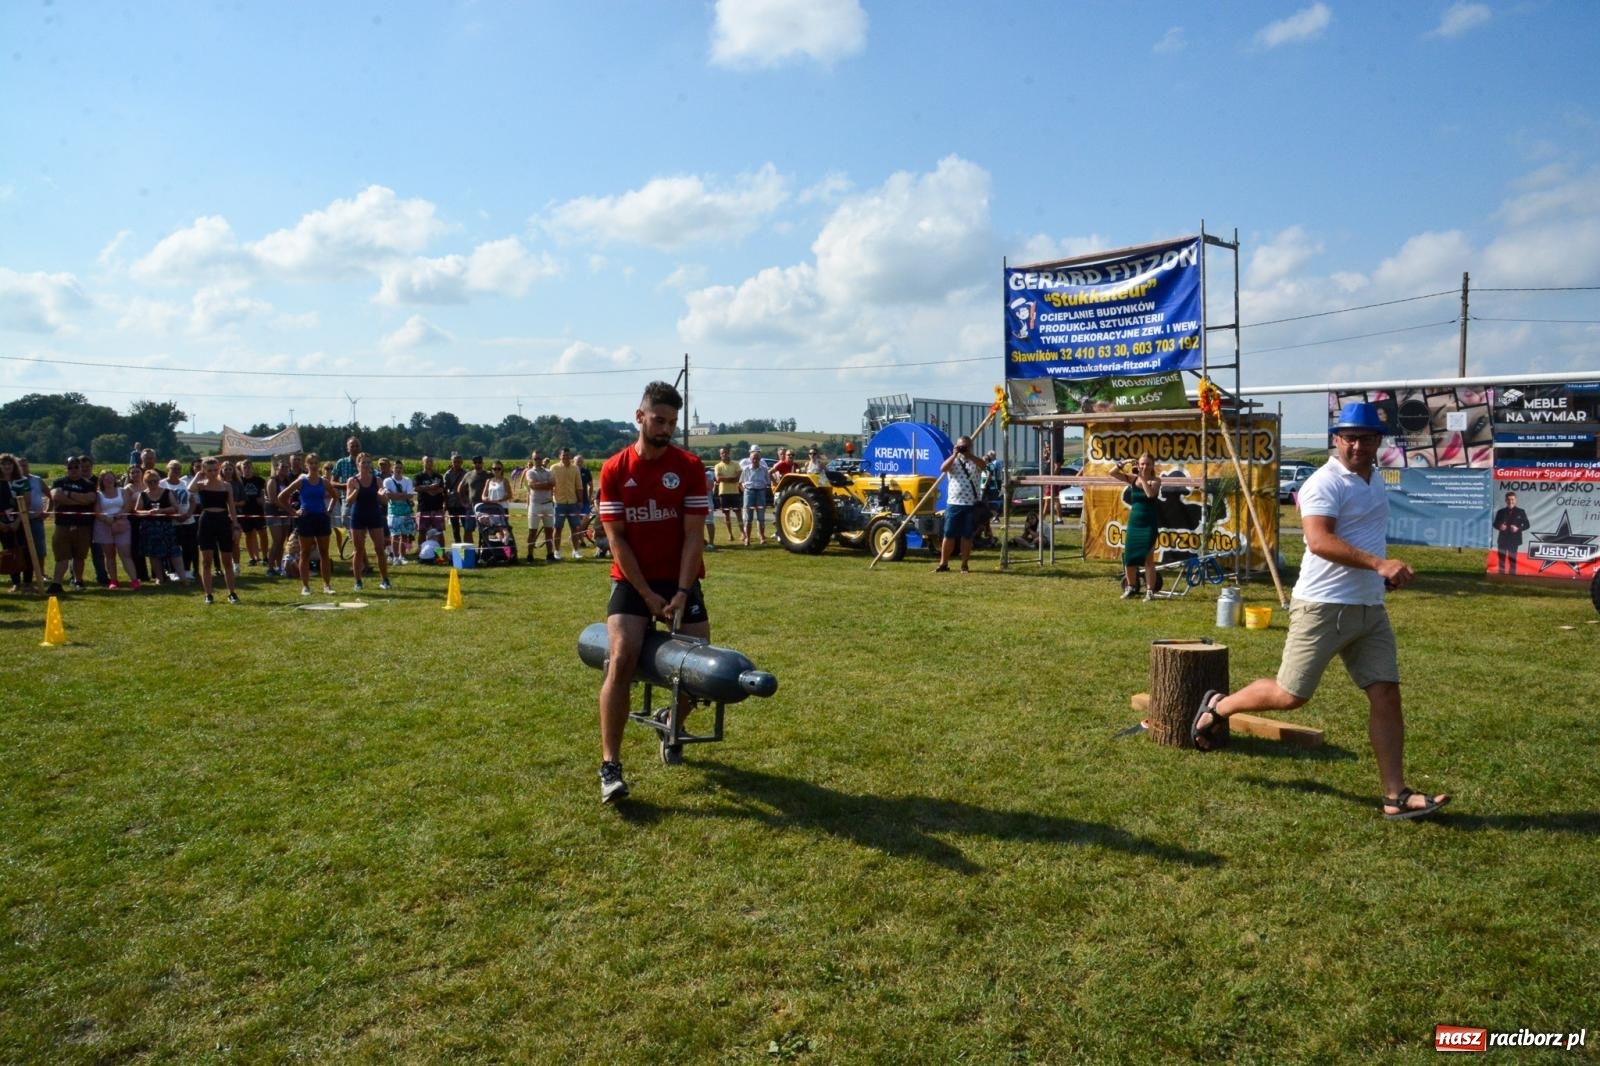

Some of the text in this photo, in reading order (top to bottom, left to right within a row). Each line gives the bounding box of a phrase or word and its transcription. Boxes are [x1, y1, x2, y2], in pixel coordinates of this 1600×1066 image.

[1009, 244, 1198, 290] GERARD FITZON
[1040, 302, 1155, 322] OCIEPLANIE BUDYNKÓW
[1039, 313, 1165, 333] PRODUKCJA SZTUKATERII
[1040, 335, 1069, 344] TYNKI
[1071, 328, 1140, 343] DEKORACYJNE
[1141, 325, 1164, 337] ZEW.
[1172, 320, 1198, 332] WEW.
[1011, 335, 1199, 362] Sławików 32 410 63 30, 603 703 192
[1046, 358, 1161, 374] www.sztukateria-fitzon.pl
[1524, 397, 1567, 409] MEBLE
[1506, 410, 1587, 422] NA WYMIAR
[874, 460, 899, 472] studio
[1497, 468, 1541, 478] Garnitury
[1544, 469, 1582, 478] Spodnie
[1500, 481, 1537, 491] MODA
[1540, 482, 1594, 493] DAMSKO
[1535, 545, 1591, 559] JustyStyl
